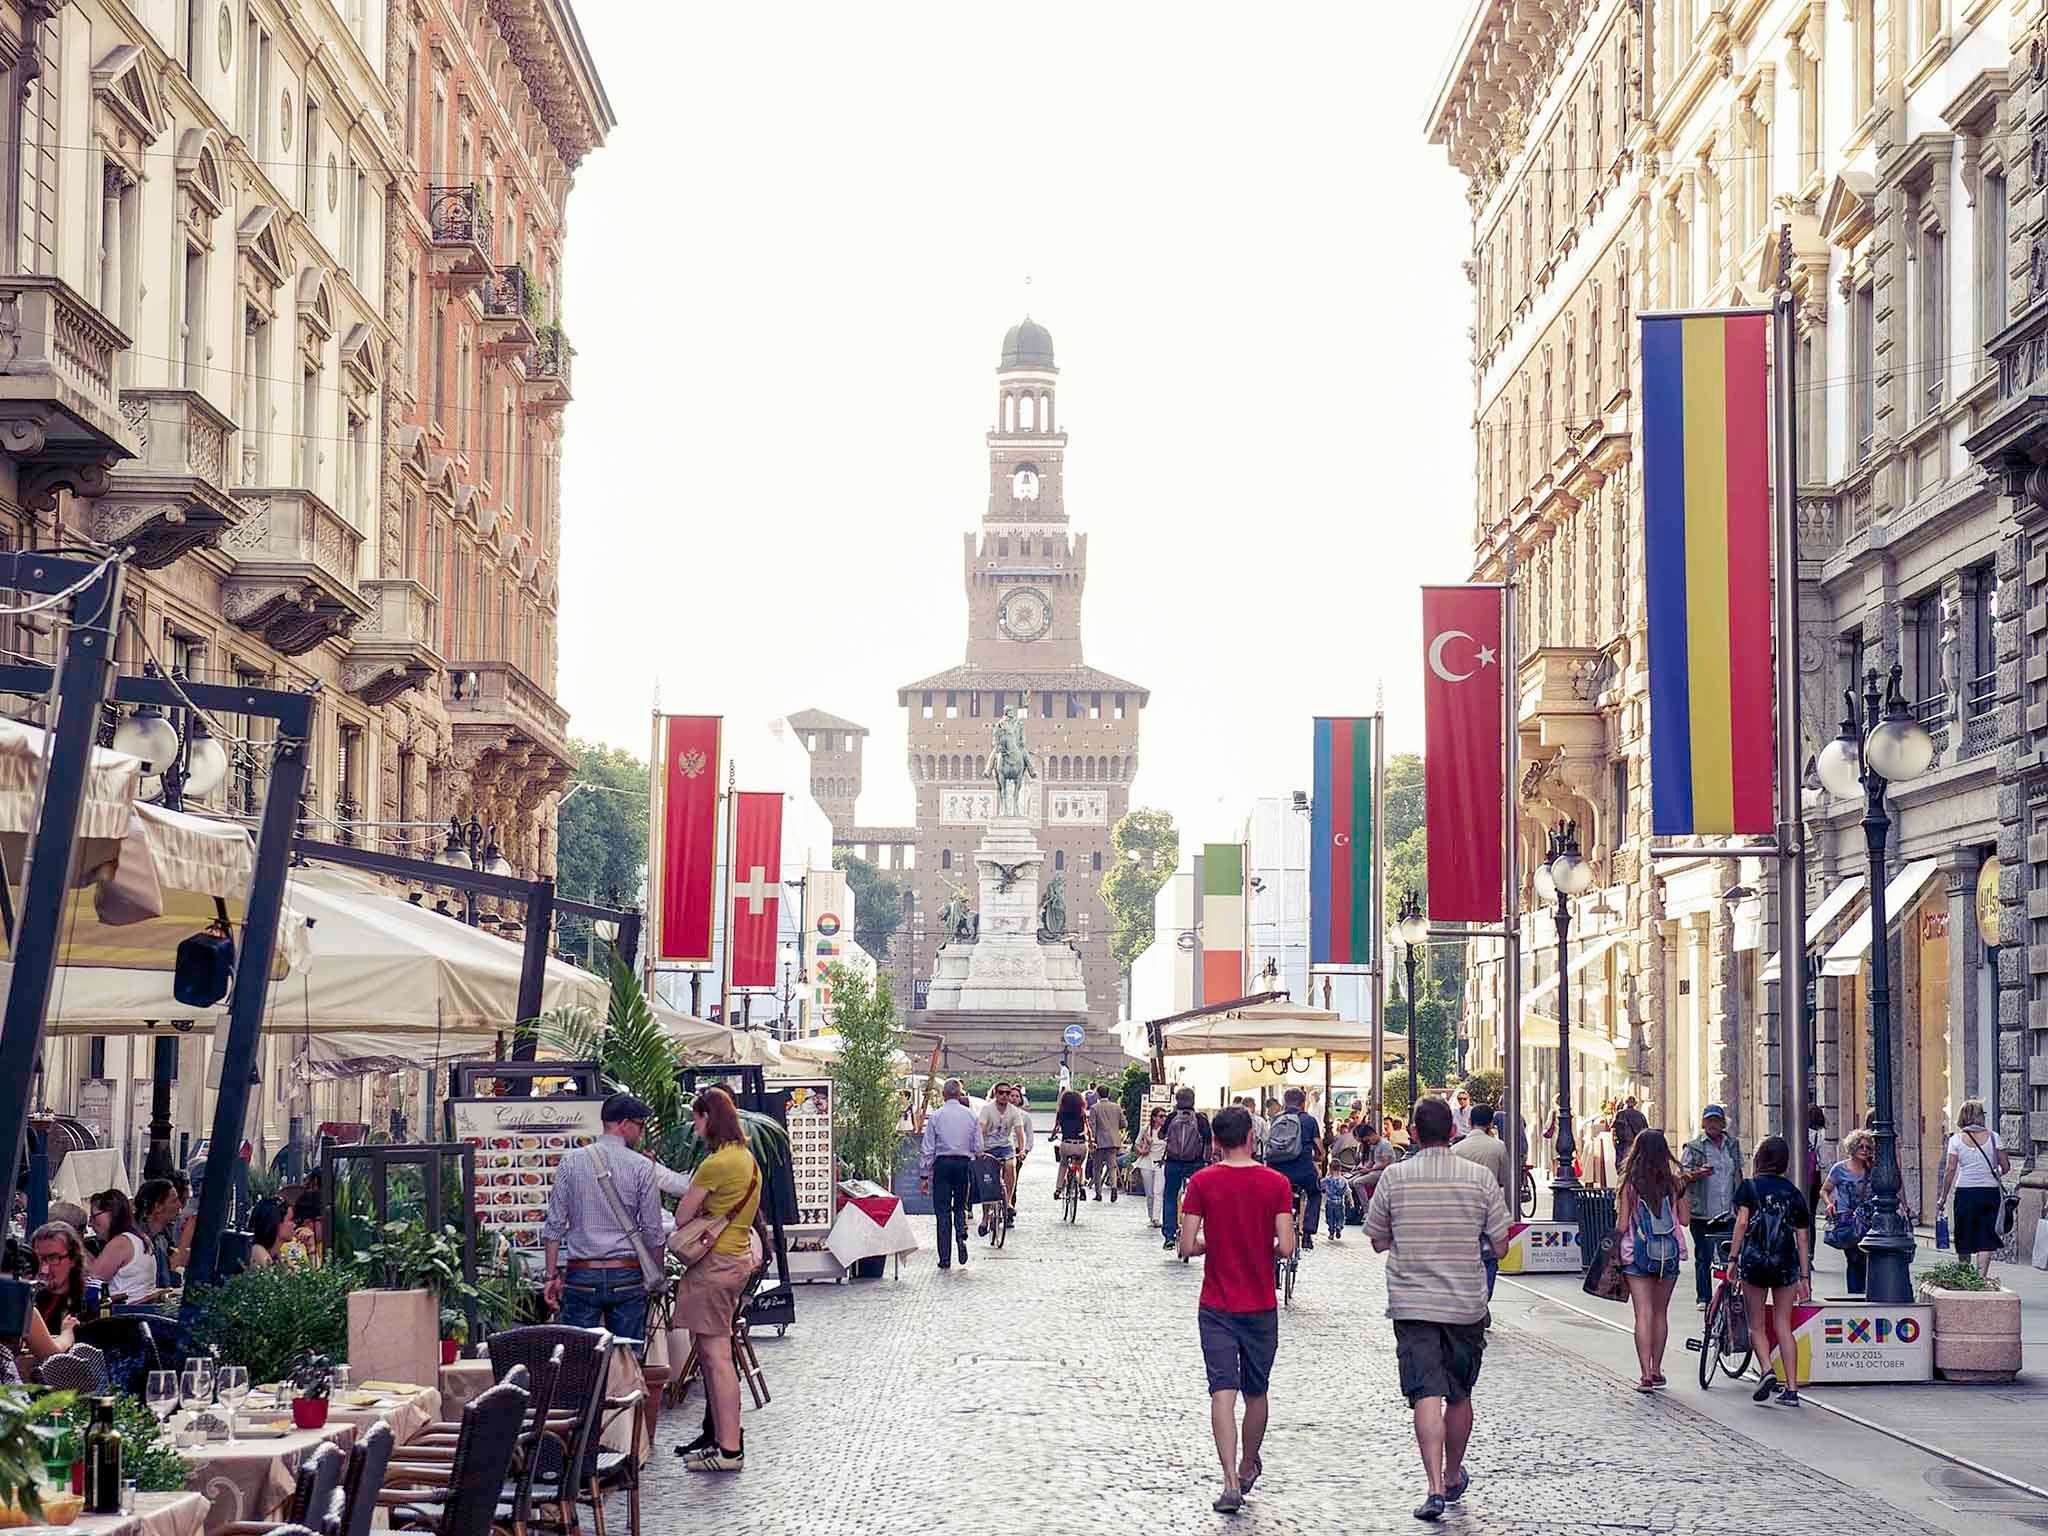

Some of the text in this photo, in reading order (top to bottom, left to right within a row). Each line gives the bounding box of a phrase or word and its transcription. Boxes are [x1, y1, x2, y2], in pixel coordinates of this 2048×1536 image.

[540, 1105, 585, 1124] Dante
[1825, 1317, 1921, 1344] EXPO
[1825, 1351, 1882, 1360] MILANO 2015
[1832, 1361, 1848, 1369] MAY
[1855, 1361, 1864, 1369] 31
[1865, 1360, 1905, 1369] OCTOBER
